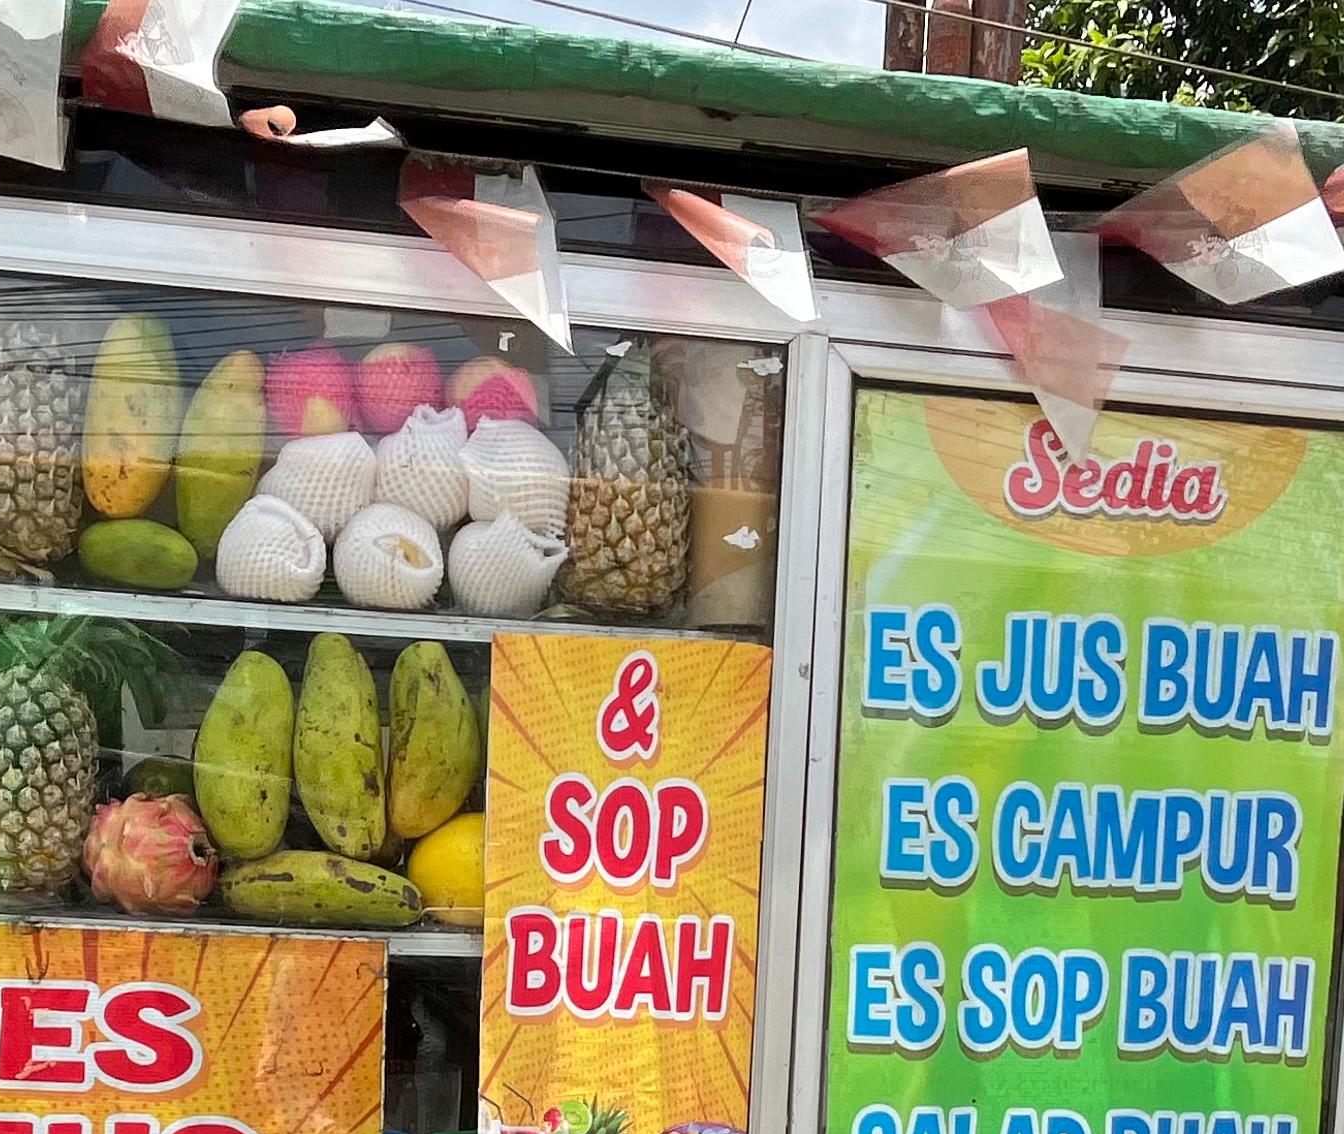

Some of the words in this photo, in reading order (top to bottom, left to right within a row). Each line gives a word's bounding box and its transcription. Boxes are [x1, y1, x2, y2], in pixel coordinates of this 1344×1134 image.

[1005, 418, 1226, 520] Sedia
[597, 649, 661, 761] &
[863, 604, 960, 717] ES
[976, 611, 1127, 727] JUS
[1139, 618, 1338, 736] BUAH
[541, 772, 709, 887] SOP
[881, 776, 978, 886] ES
[993, 782, 1302, 899] CAMPUR
[506, 904, 735, 1021] BUAH
[848, 941, 945, 1049] ES
[957, 943, 1108, 1051] SOP
[1119, 948, 1315, 1057] BUAH
